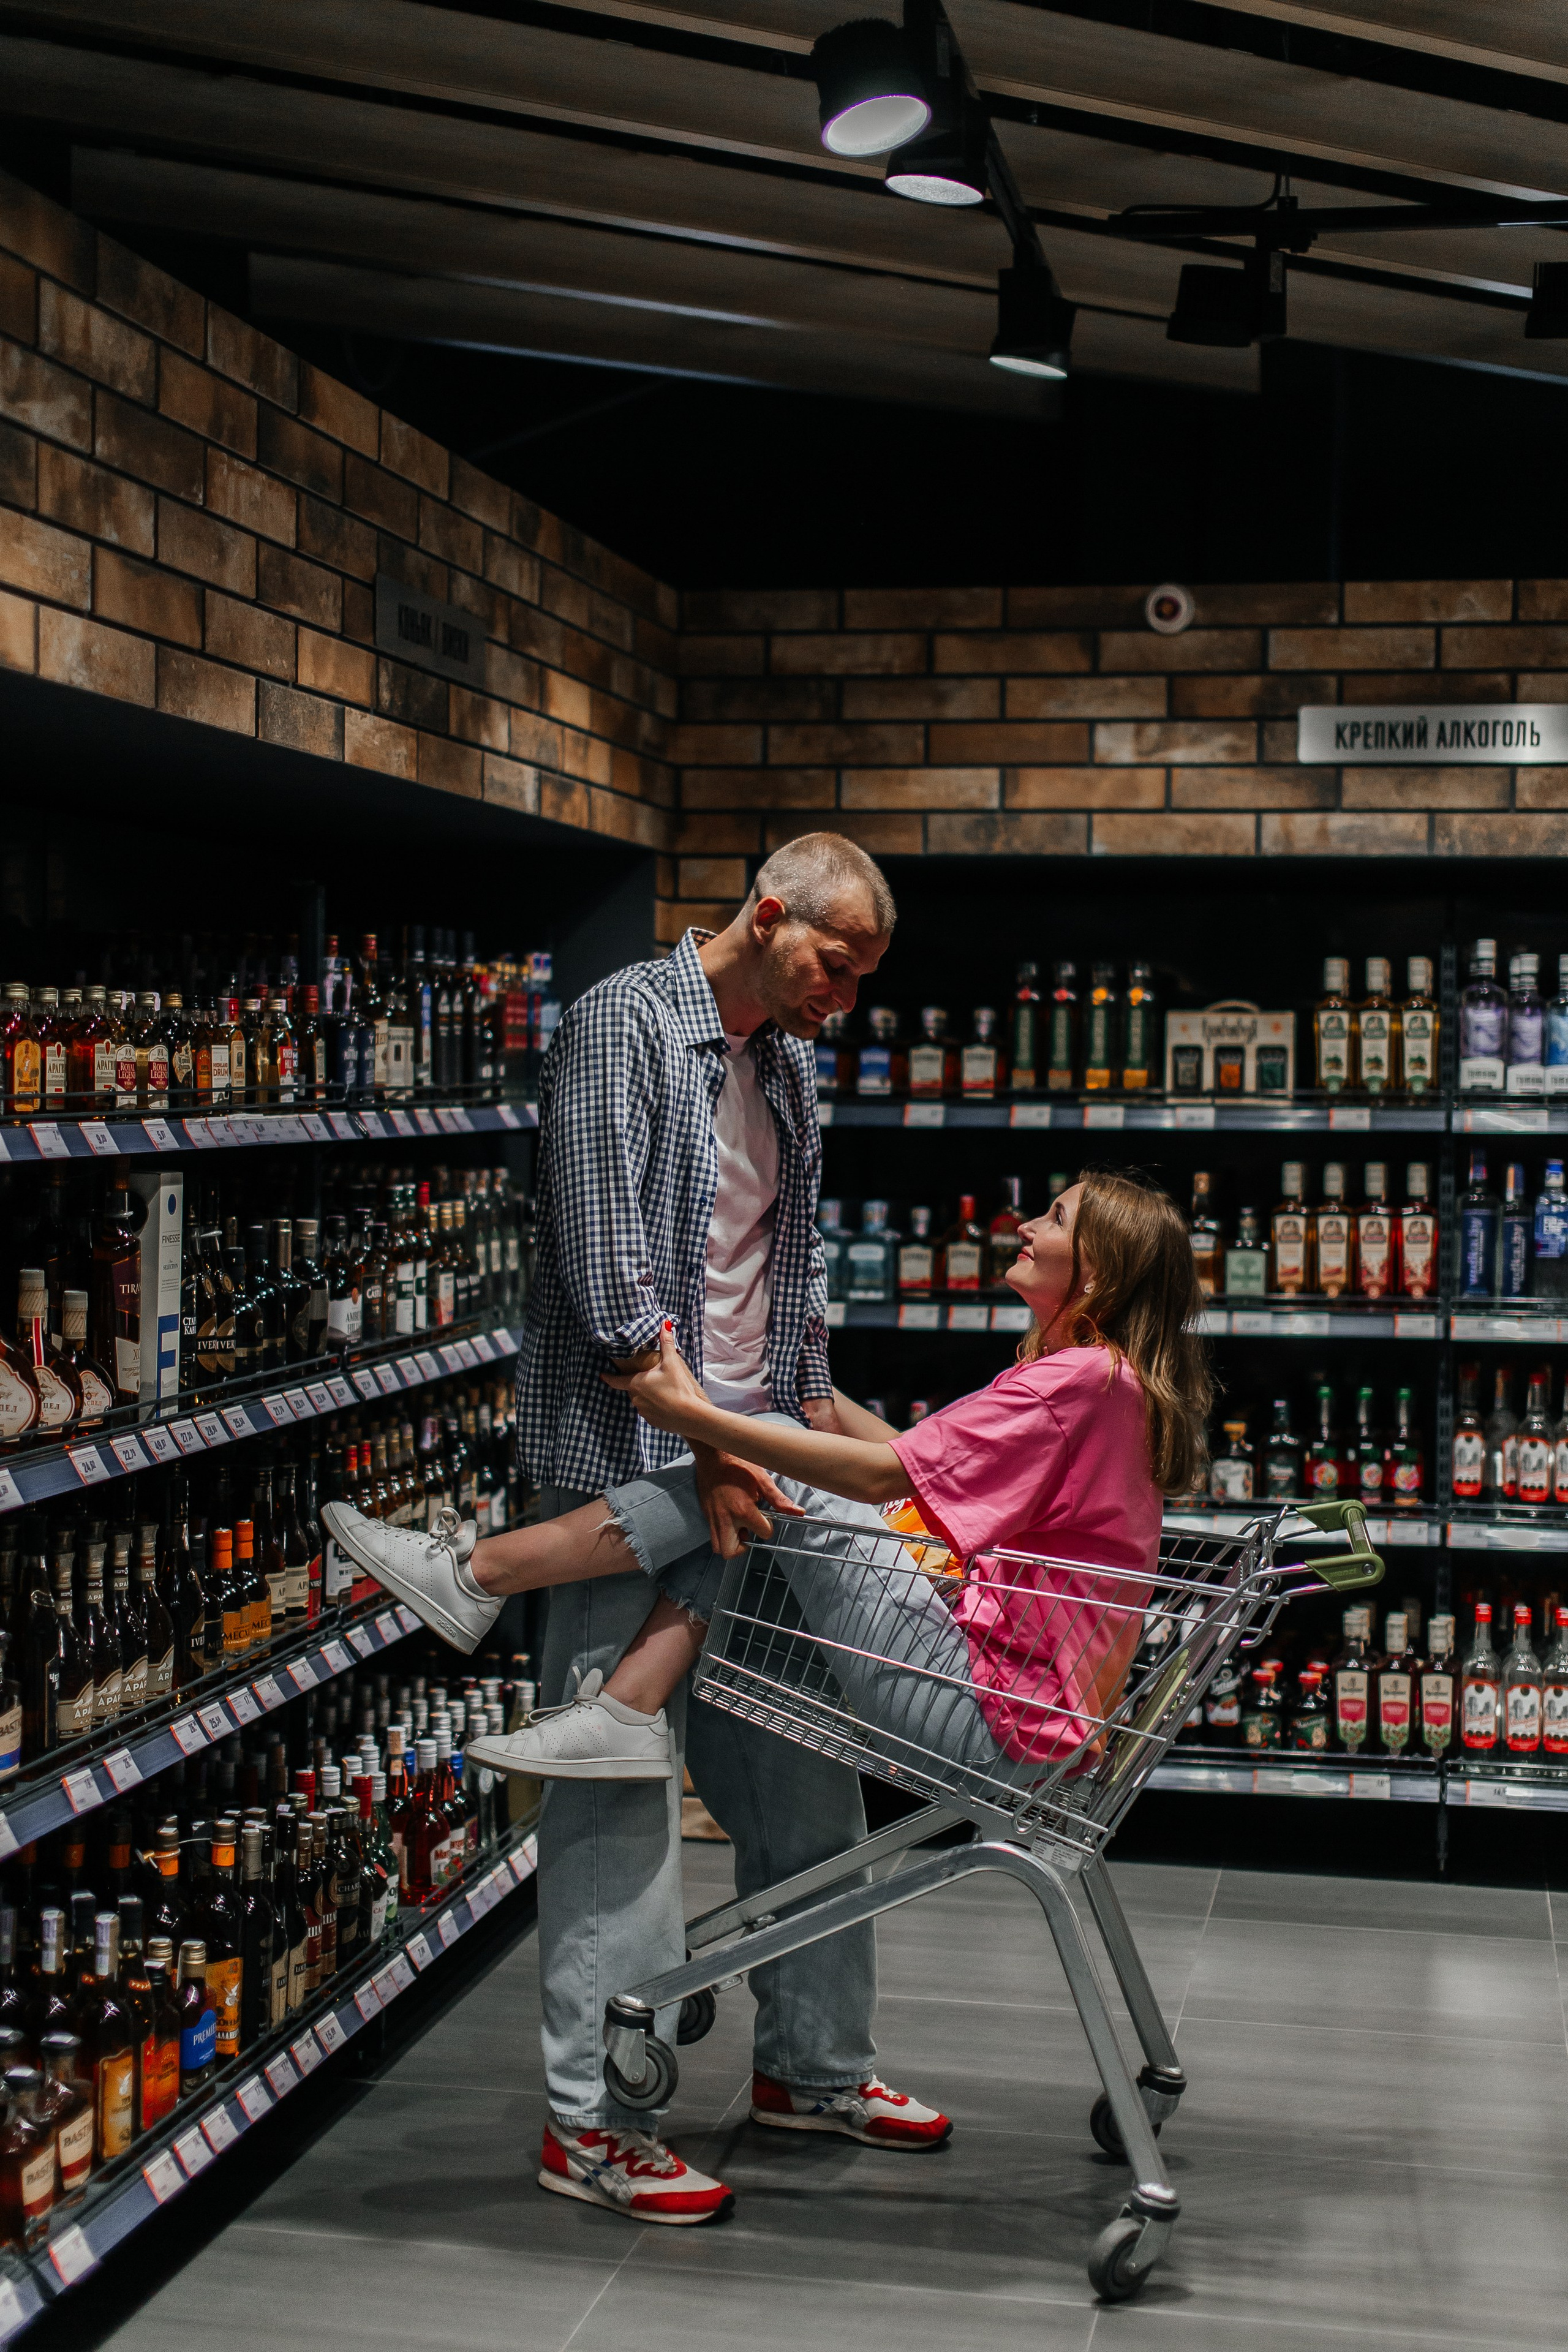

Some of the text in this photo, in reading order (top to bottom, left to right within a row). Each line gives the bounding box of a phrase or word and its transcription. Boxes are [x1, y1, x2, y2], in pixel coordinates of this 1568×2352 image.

[1335, 715, 1541, 749] КРЕПКИЙ АЛКОГОЛЬ
[120, 1061, 135, 1071] ROYAL
[153, 1061, 167, 1071] ROYAL
[213, 1068, 228, 1077] DRUM
[162, 1234, 181, 1244] FINESSE
[216, 1339, 236, 1350] IVER
[436, 1616, 457, 1638] adidas
